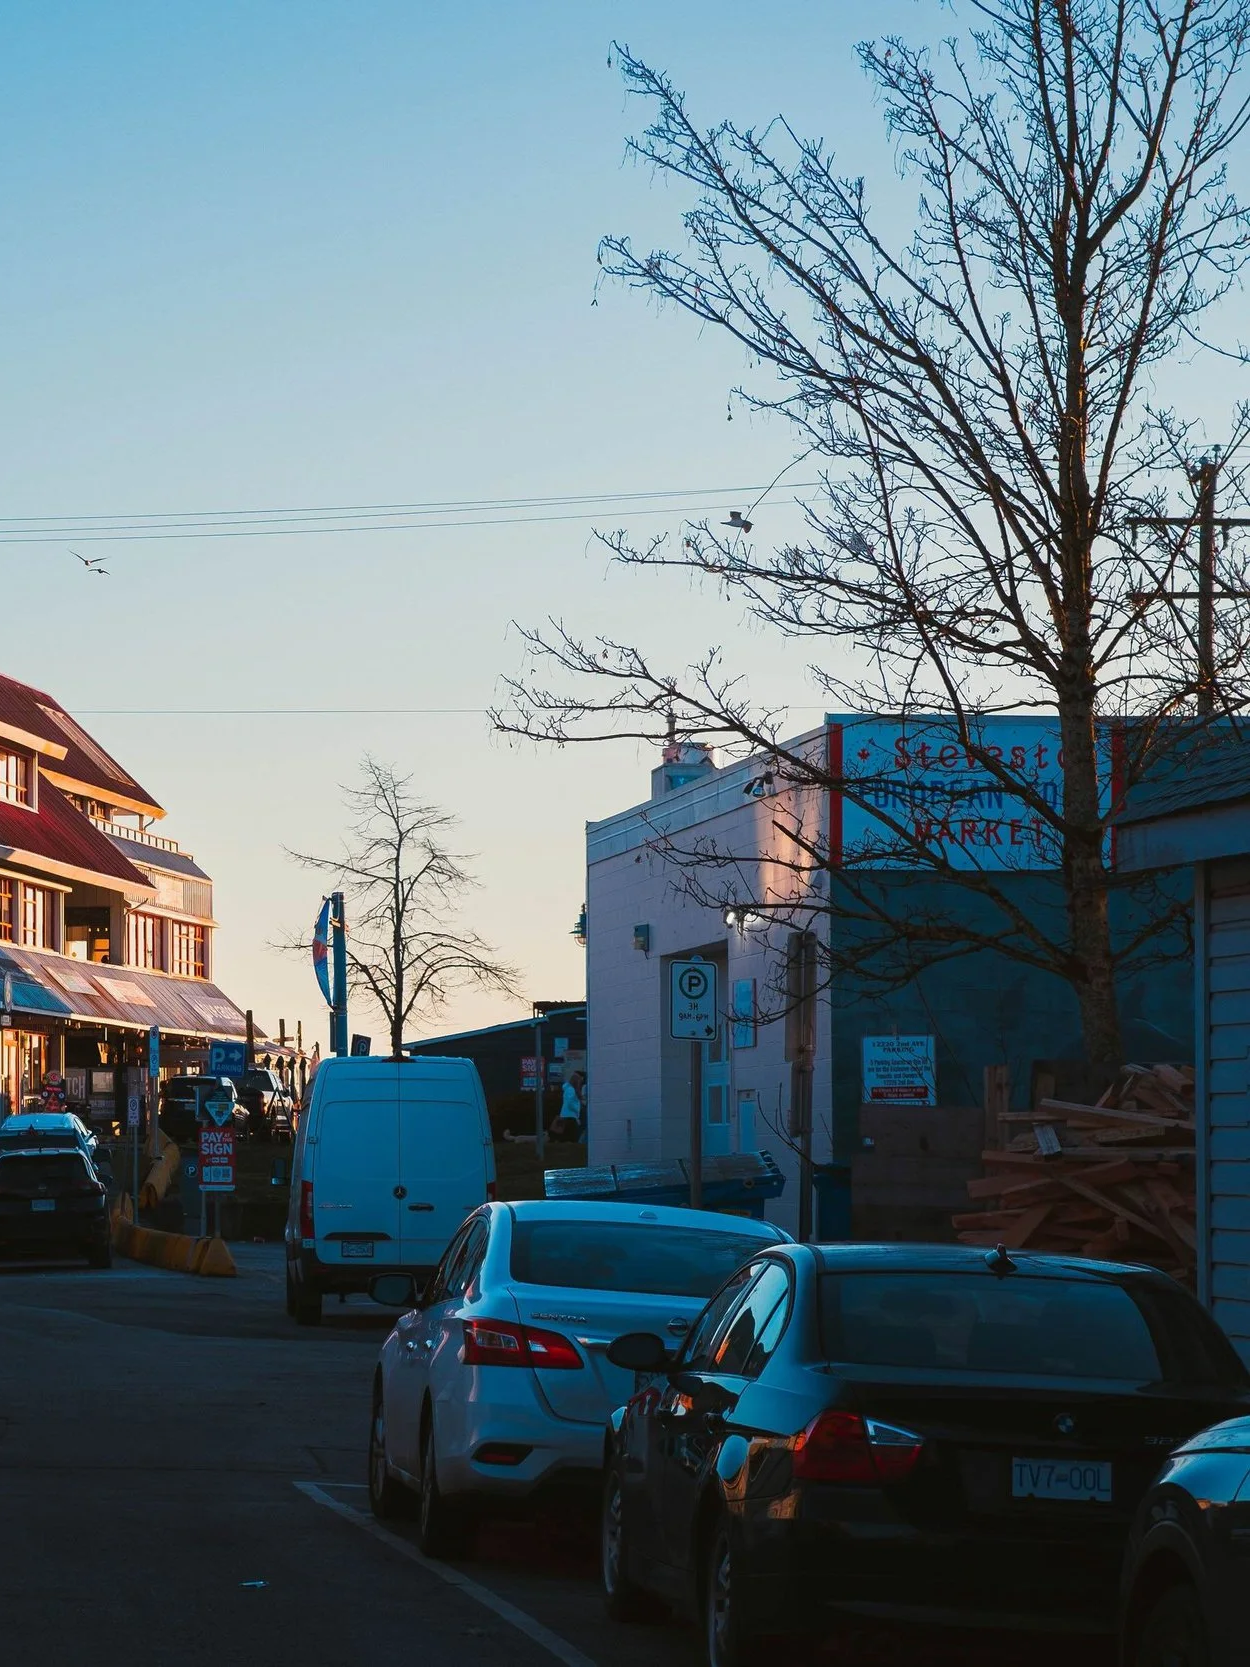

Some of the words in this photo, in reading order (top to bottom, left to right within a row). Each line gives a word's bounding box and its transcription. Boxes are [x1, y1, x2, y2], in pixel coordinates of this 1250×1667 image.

[914, 818, 1046, 845] MARKET
[688, 975, 701, 992] P
[201, 1131, 223, 1143] PAY
[201, 1142, 233, 1155] SIGN
[530, 1311, 588, 1324] SENTRA
